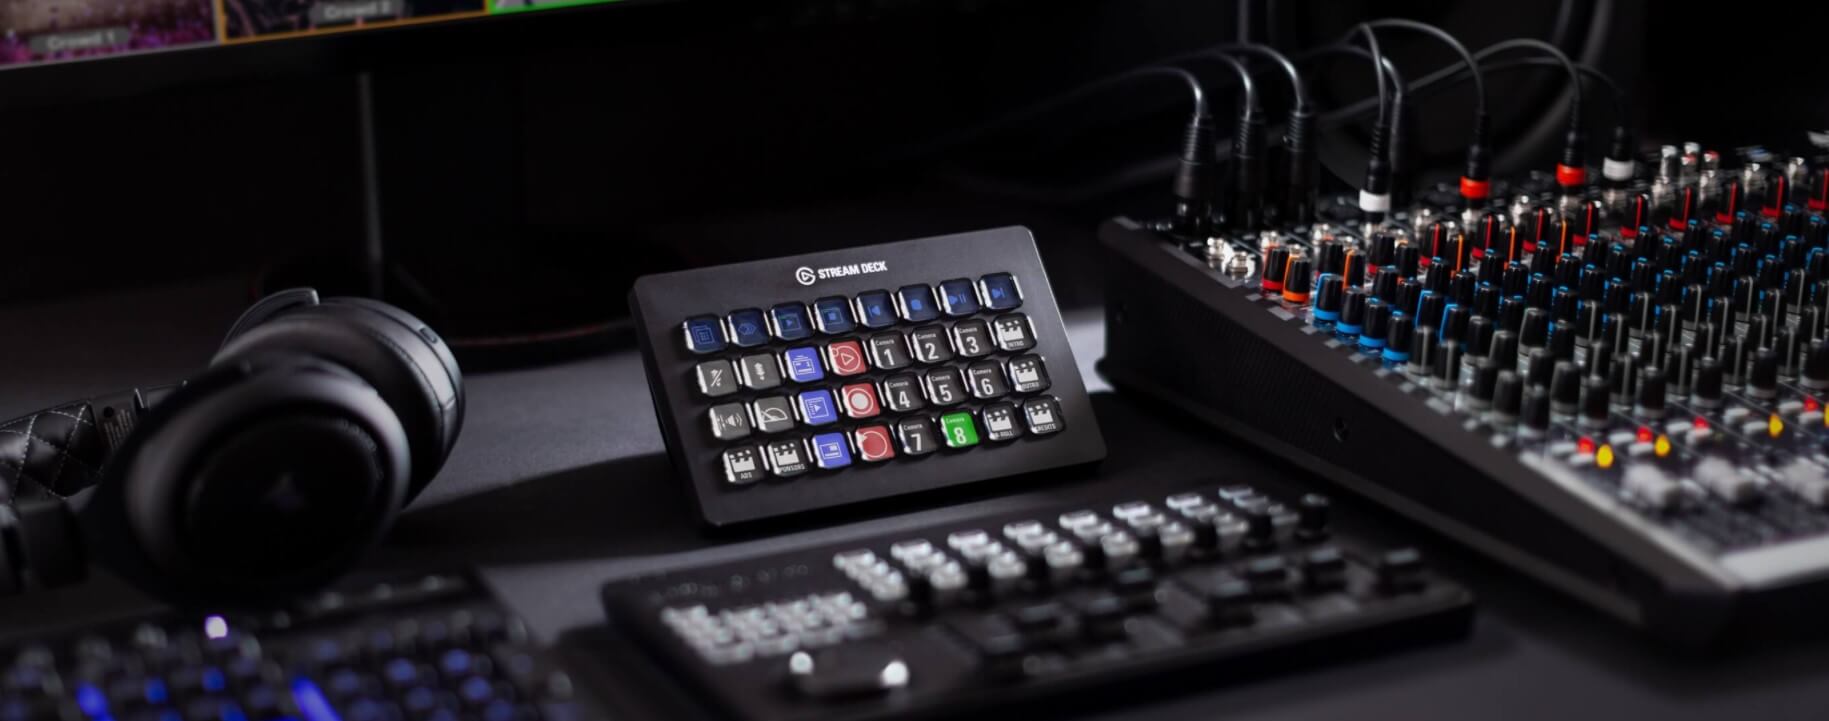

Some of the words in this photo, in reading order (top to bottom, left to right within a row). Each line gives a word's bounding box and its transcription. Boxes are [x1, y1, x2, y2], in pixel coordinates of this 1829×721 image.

[47, 32, 102, 50] Crowd
[818, 264, 860, 279] STREAM
[861, 261, 888, 274] DECK
[917, 331, 936, 340] Camera
[959, 326, 978, 334] Camera
[876, 338, 895, 346] Camera
[966, 336, 980, 354] 3
[883, 349, 895, 366] 1
[924, 342, 939, 360] 2
[931, 374, 950, 382] Camera
[973, 368, 992, 376] Camera
[938, 384, 953, 401] 5
[981, 378, 994, 396] 6
[899, 391, 911, 408] 4
[903, 423, 923, 431] Camera
[945, 416, 965, 424] Camera
[911, 433, 922, 451] 7
[953, 427, 967, 445] 8
